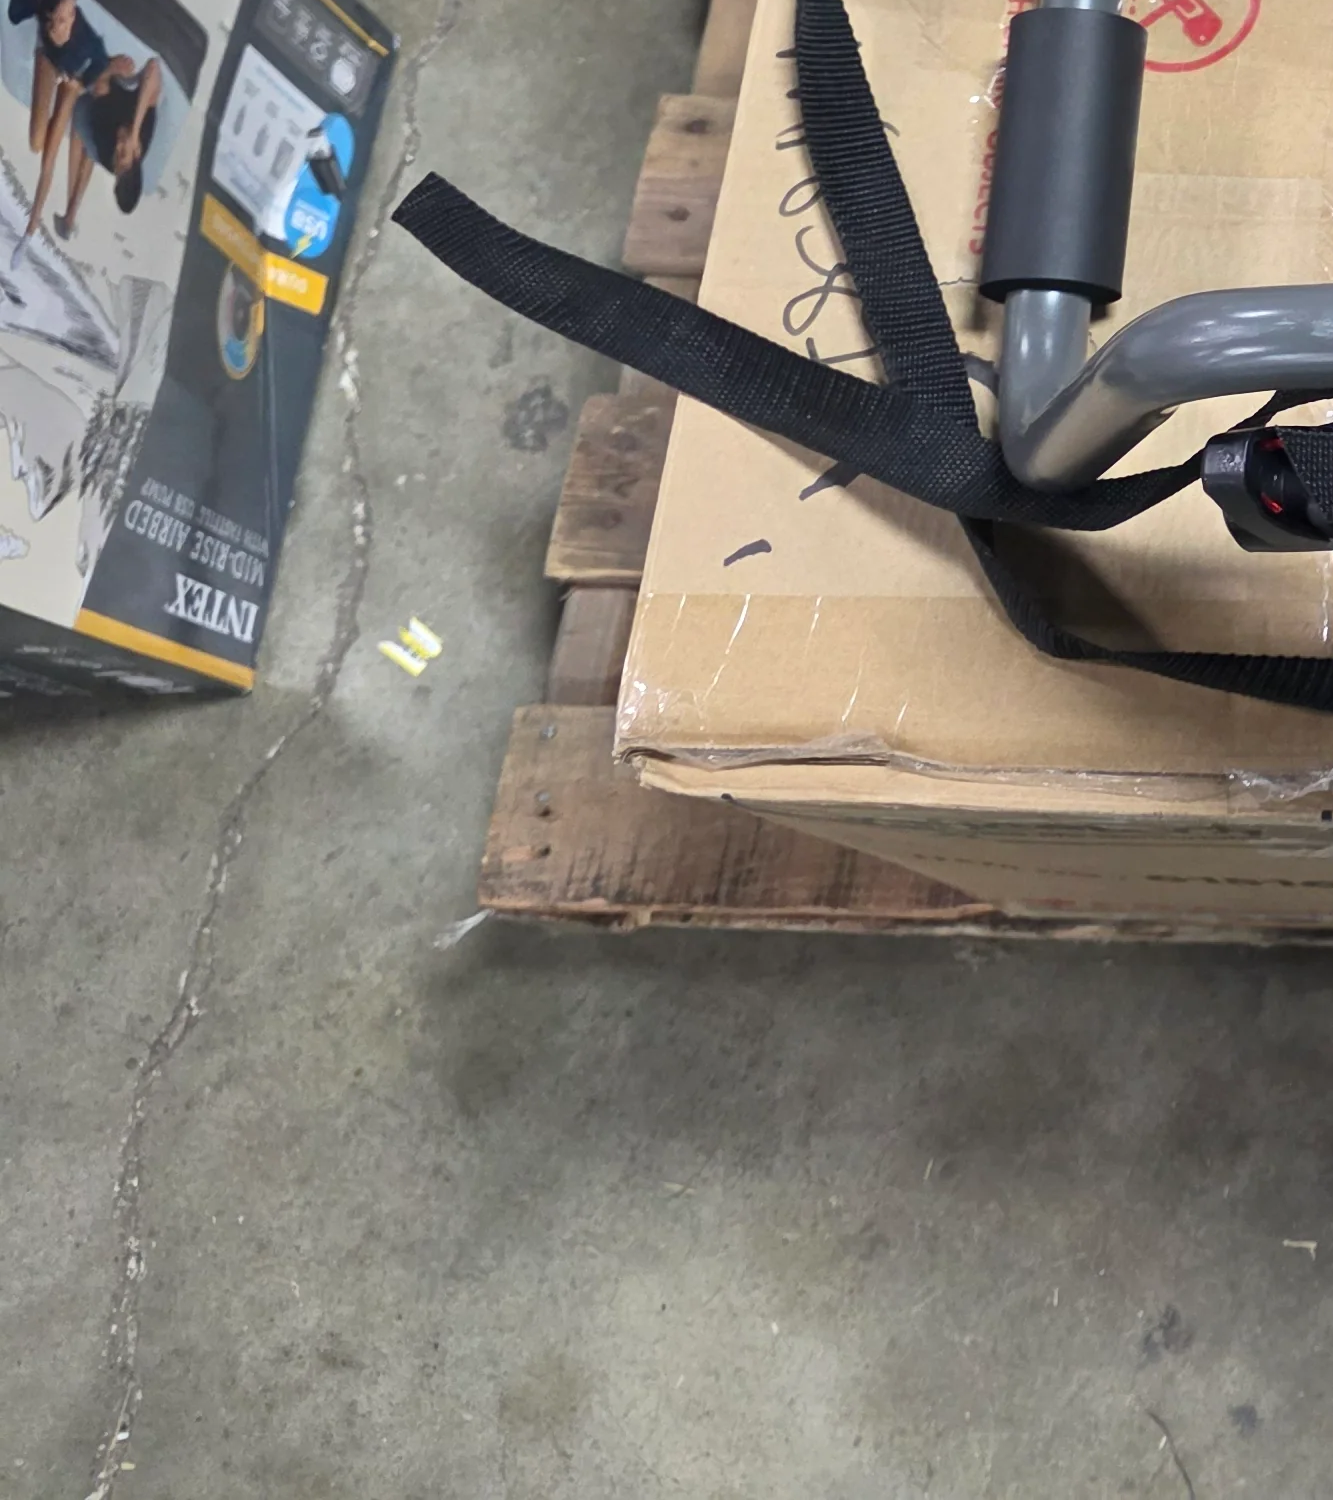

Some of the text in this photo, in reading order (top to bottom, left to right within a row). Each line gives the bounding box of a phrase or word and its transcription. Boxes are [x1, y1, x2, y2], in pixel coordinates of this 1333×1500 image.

[289, 209, 327, 241] USB
[122, 498, 264, 587] MID-RISE AIRBED
[161, 571, 258, 643] INTEX
